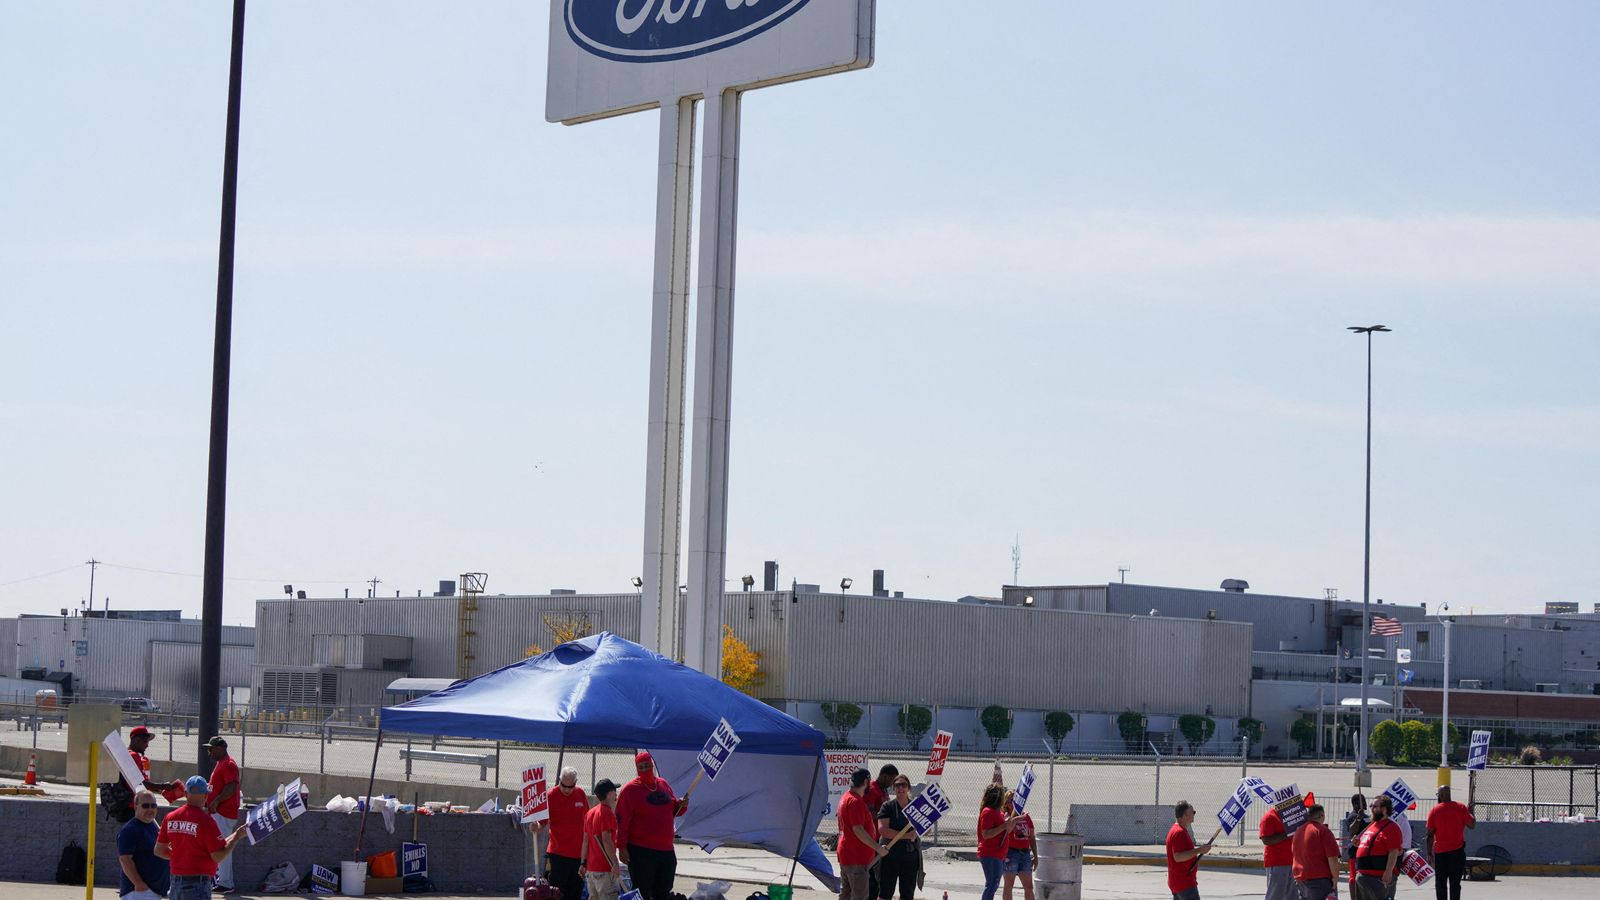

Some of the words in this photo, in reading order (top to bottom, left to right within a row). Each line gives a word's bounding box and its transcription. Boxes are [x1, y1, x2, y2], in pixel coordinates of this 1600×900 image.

[615, 0, 761, 35] Fo
[716, 722, 736, 750] UAW
[935, 733, 951, 747] AW
[1473, 733, 1490, 744] UAW
[711, 744, 723, 757] ON
[931, 749, 942, 761] ON
[699, 750, 722, 772] STRIKE
[928, 758, 944, 772] RIKE
[1469, 755, 1486, 768] STRIKE
[522, 767, 544, 783] UAW
[527, 786, 537, 800] ON
[926, 784, 949, 813] UAW
[1236, 783, 1252, 808] UAW
[1274, 786, 1294, 802] UAW
[1392, 781, 1415, 803] UAW
[523, 791, 547, 817] STRIKE
[919, 803, 934, 816] ON
[1229, 803, 1240, 816] ON
[1282, 805, 1301, 816] SAVING
[905, 804, 932, 829] STRIKE
[1219, 808, 1238, 828] STRIKE
[1282, 809, 1308, 823] AMERICAN
[167, 821, 198, 832] POWER
[404, 846, 426, 862] STRIKE
[316, 866, 335, 882] UAW
[411, 860, 420, 872] ON
[1414, 866, 1433, 884] UAW
